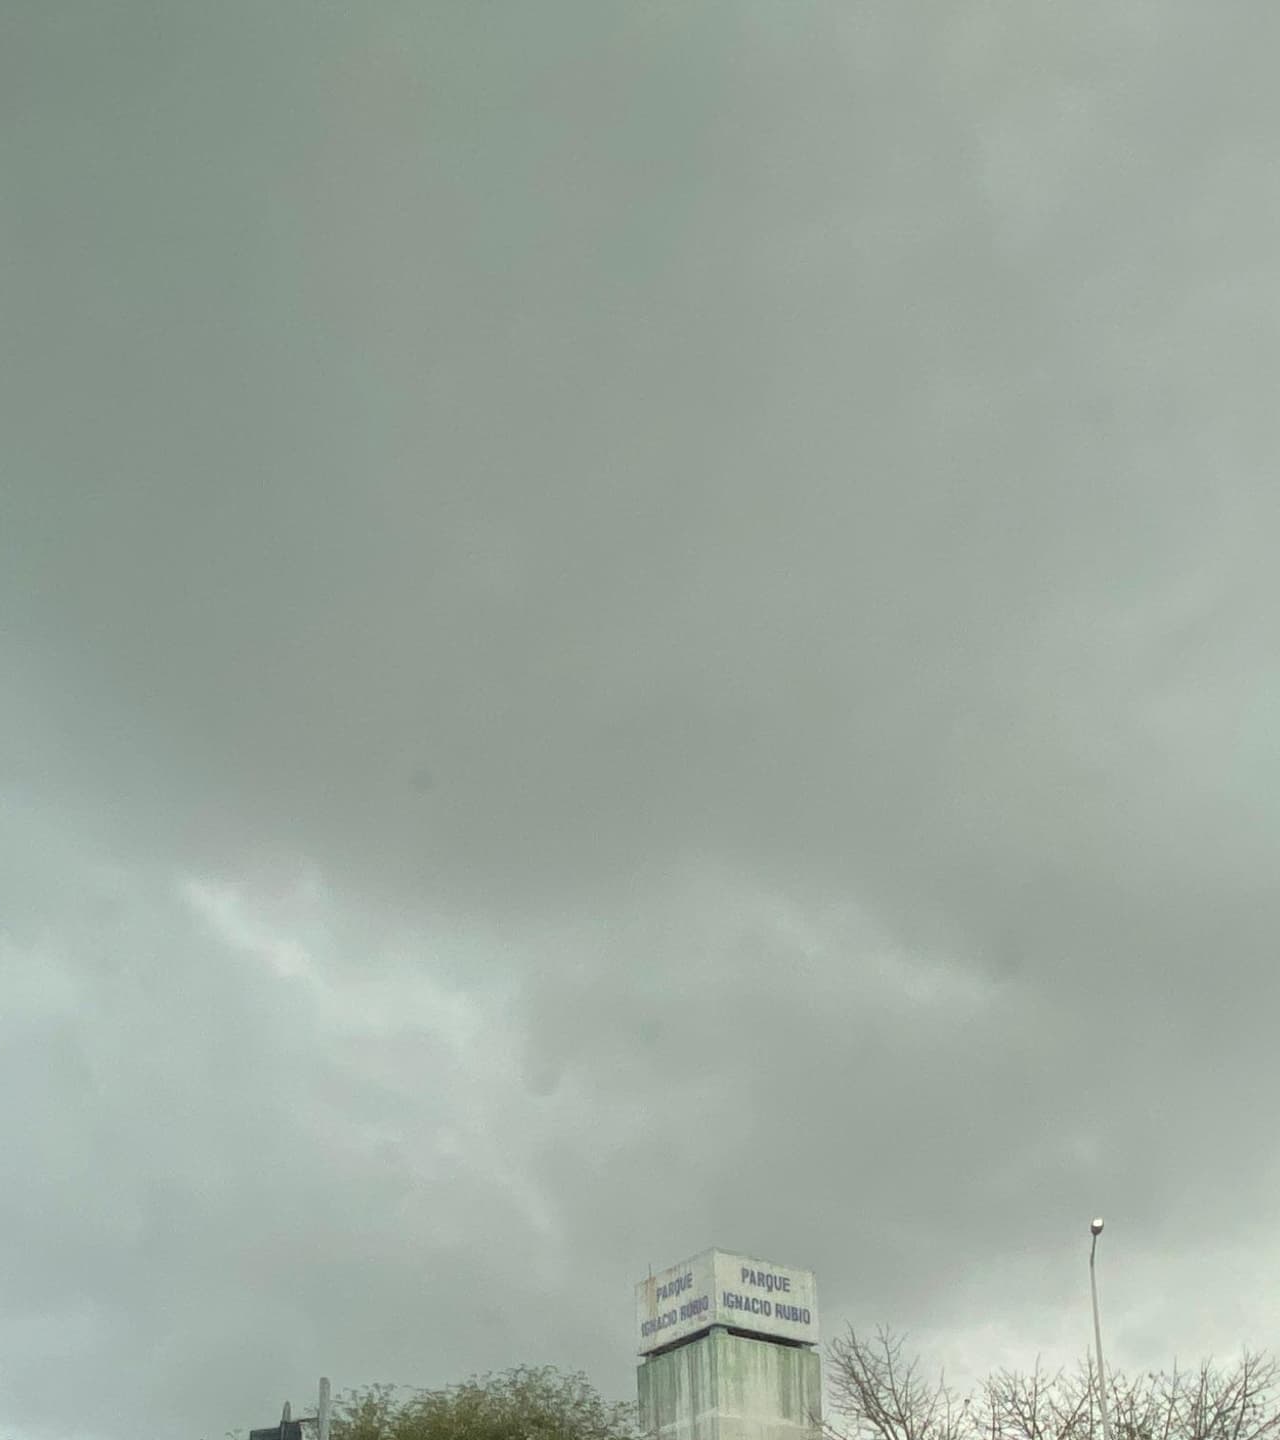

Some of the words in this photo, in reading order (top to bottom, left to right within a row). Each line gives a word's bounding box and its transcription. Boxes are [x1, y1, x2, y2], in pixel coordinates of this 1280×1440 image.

[656, 1272, 693, 1303] PARQUE
[741, 1267, 791, 1293] PARQUE
[641, 1309, 677, 1337] IGNACIO
[680, 1296, 709, 1321] RUBIO
[722, 1291, 772, 1317] IGNACIO
[775, 1303, 811, 1325] RUBIO
